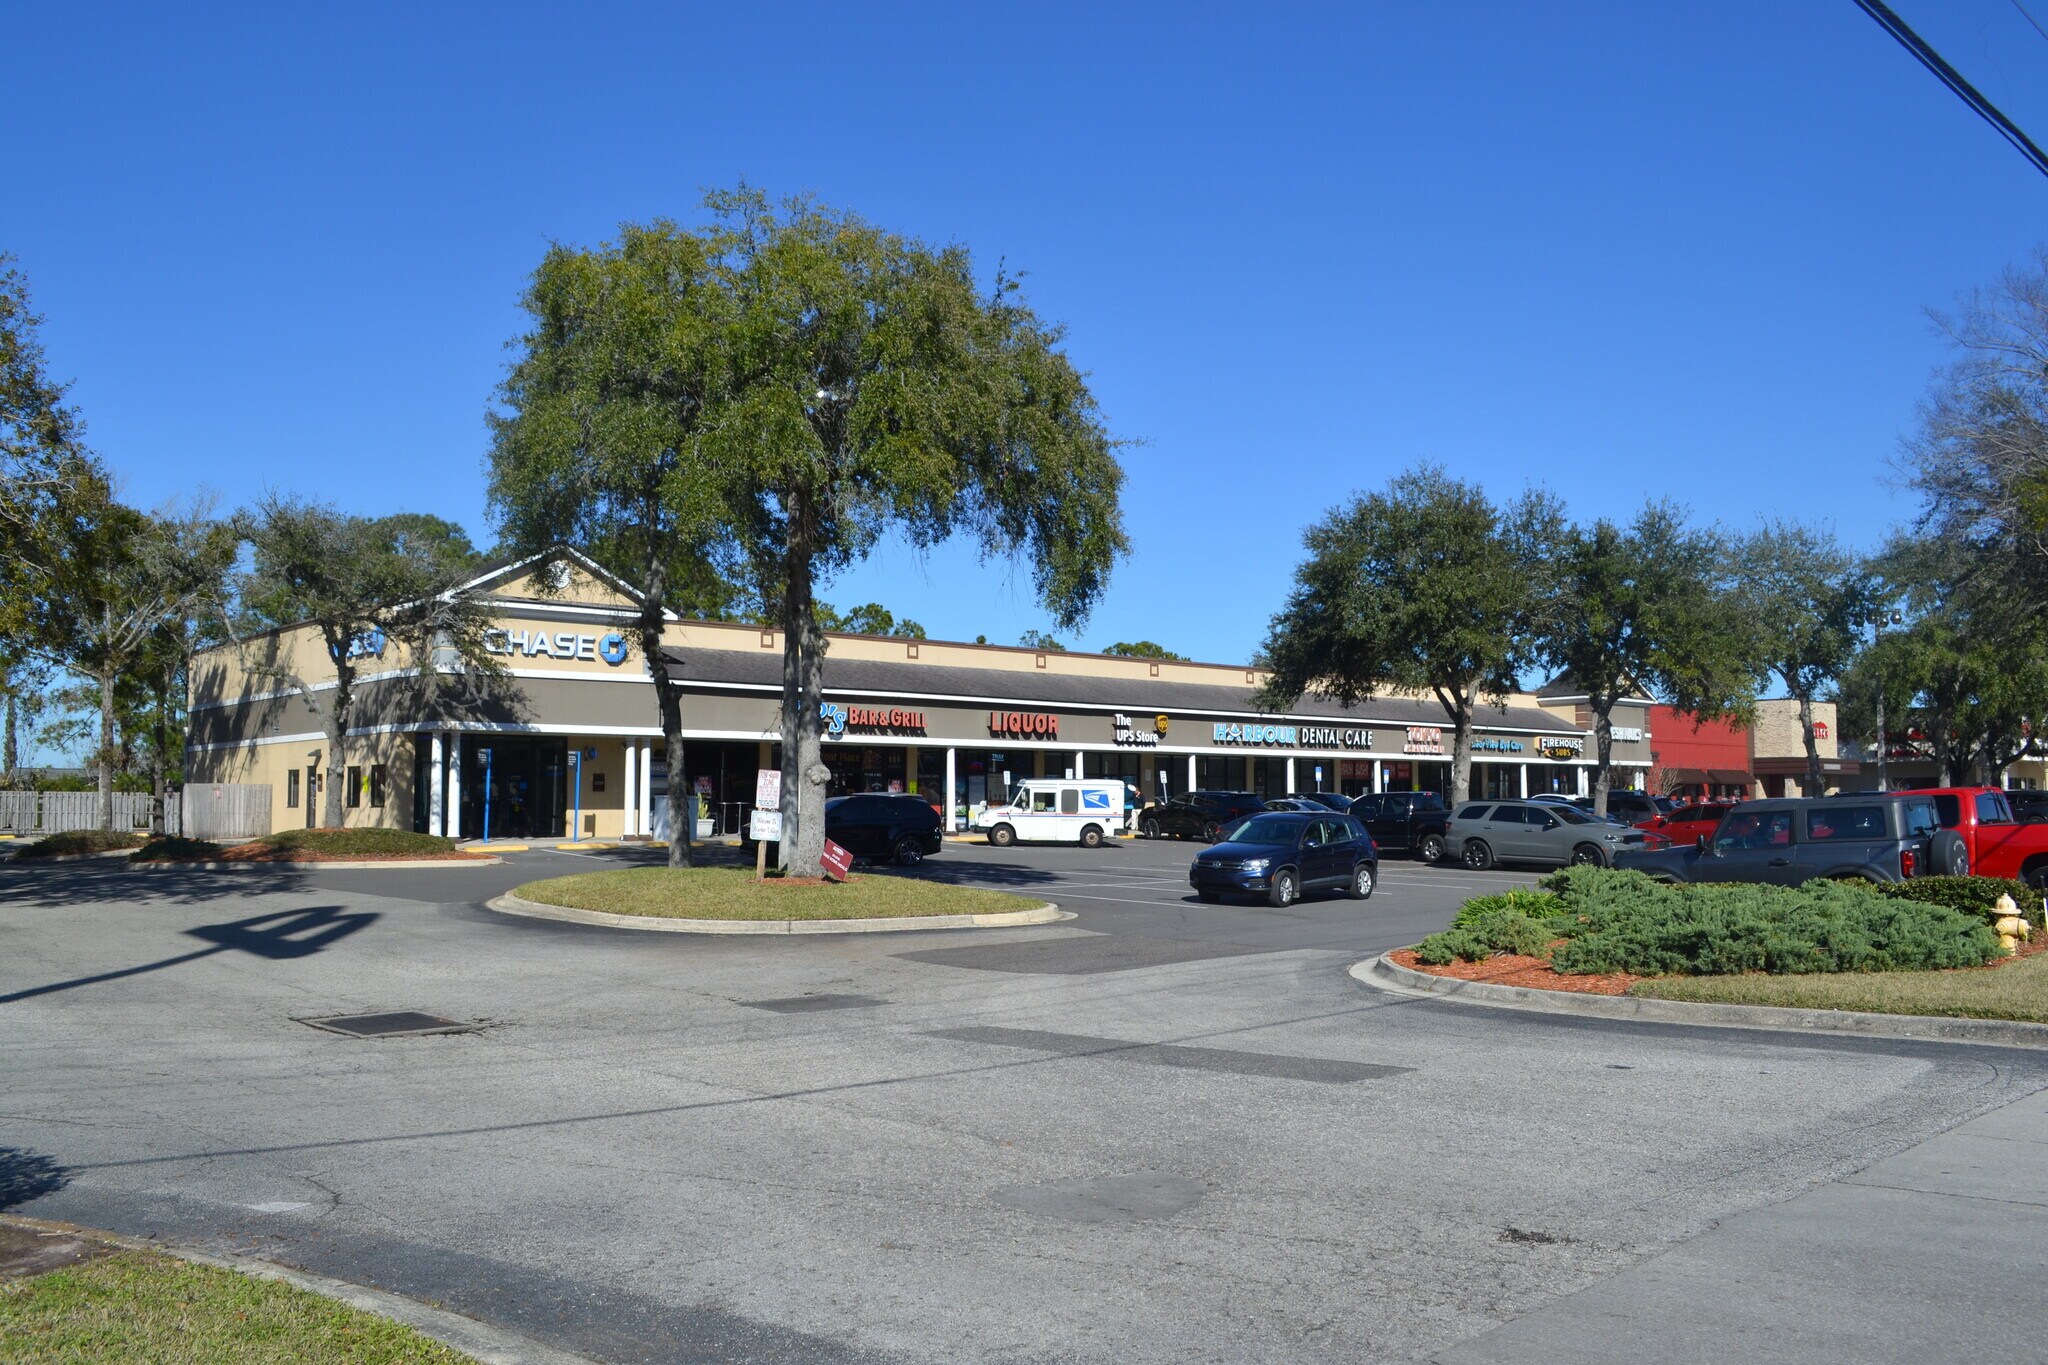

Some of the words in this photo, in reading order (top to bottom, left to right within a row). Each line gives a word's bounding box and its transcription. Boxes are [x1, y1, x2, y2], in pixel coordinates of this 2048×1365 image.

[484, 629, 596, 659] CHASE
[890, 708, 929, 728] GRILL
[991, 711, 1059, 734] LIQUOR
[1115, 713, 1132, 726] The
[1116, 729, 1135, 742] UPS
[1136, 730, 1159, 744] Store
[1213, 723, 1297, 745] HARBOUR
[1301, 727, 1341, 745] DENTAL
[1345, 730, 1373, 746] CARE
[1541, 737, 1584, 753] FIREHOUSE
[1555, 748, 1571, 757] SUBS
